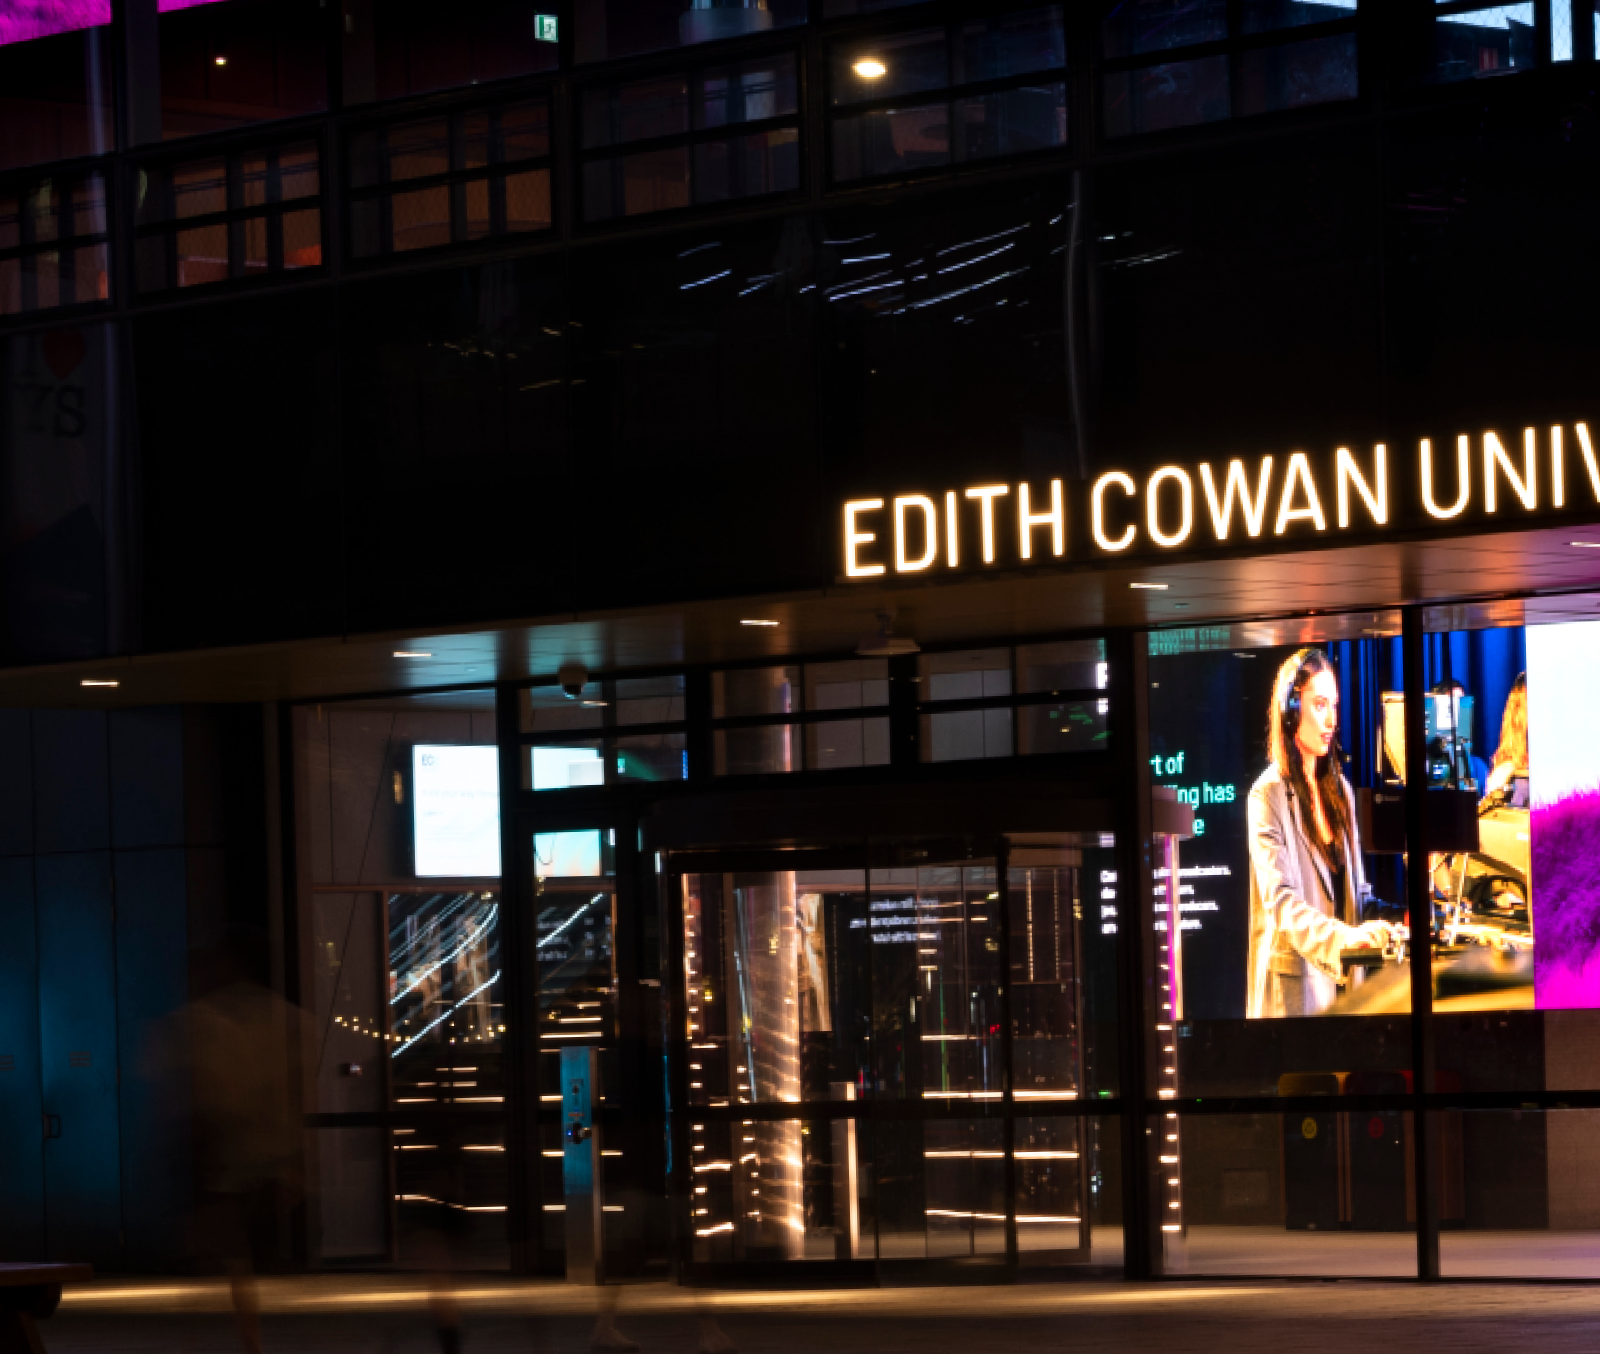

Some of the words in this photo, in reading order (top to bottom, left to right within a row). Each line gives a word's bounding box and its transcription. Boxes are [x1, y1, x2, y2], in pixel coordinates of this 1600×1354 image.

[843, 478, 1065, 579] EDITH
[1090, 443, 1390, 552] COWAN
[1165, 750, 1185, 775] of
[1203, 782, 1235, 803] has
